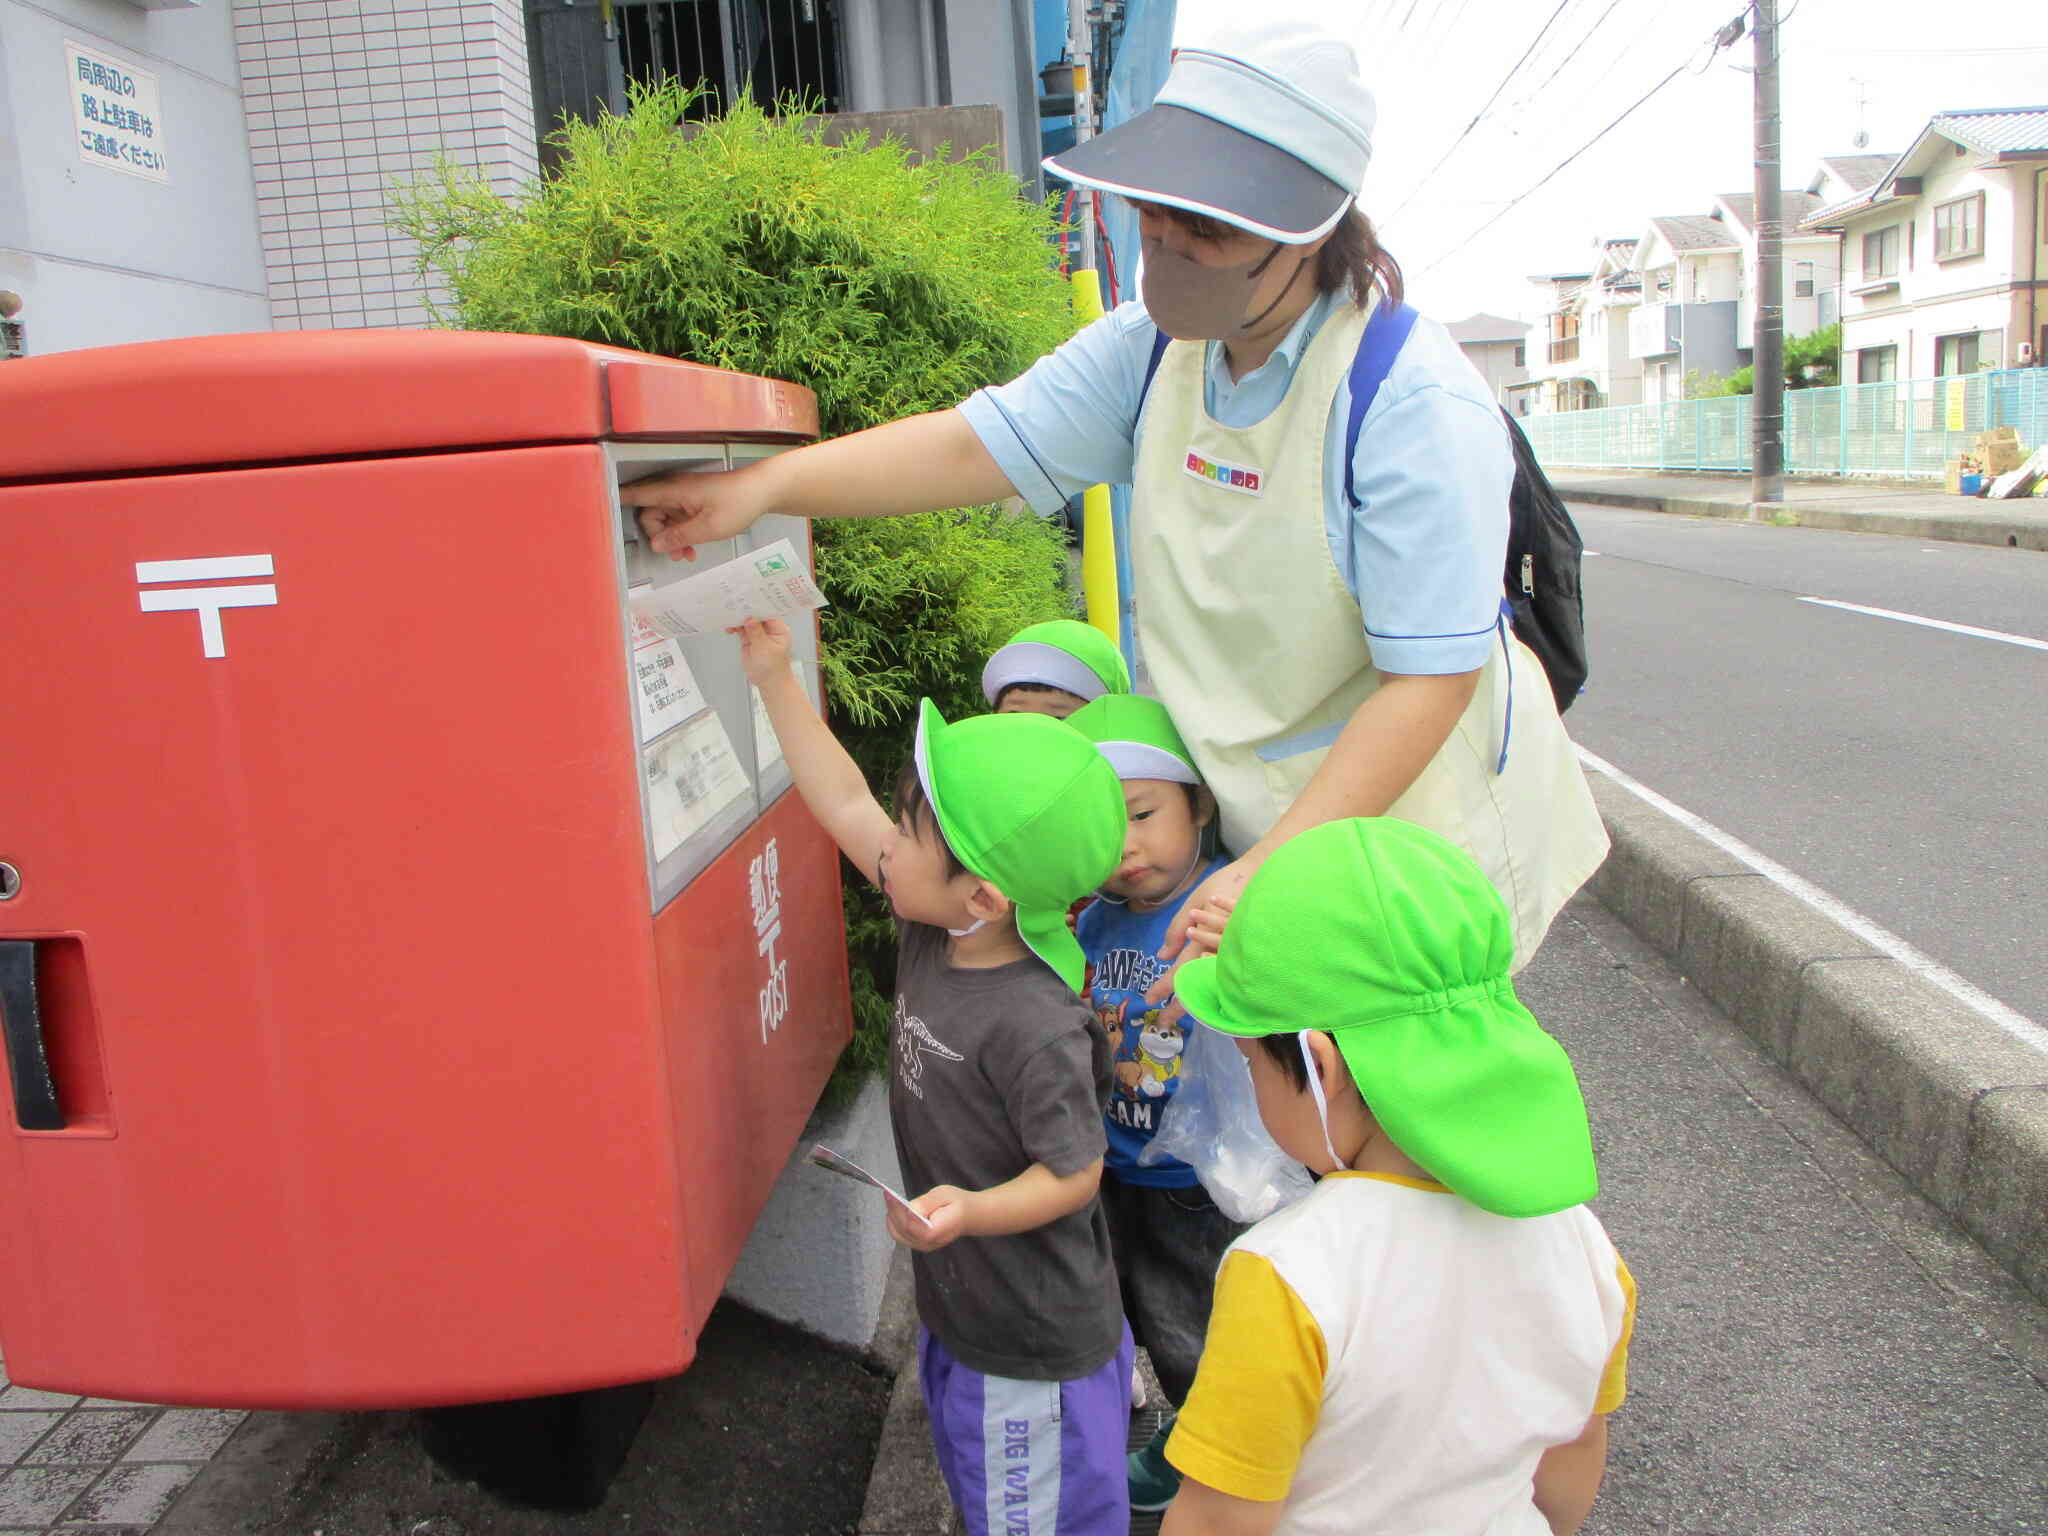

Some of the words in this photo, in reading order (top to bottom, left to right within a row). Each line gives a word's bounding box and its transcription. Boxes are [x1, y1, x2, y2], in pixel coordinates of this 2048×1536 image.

[77, 56, 136, 98] 局周辺の
[81, 93, 153, 138] 路上駐車は
[80, 129, 166, 170] ご遠慮ください
[760, 960, 788, 1044] POST
[1004, 1419, 1029, 1459] BIG
